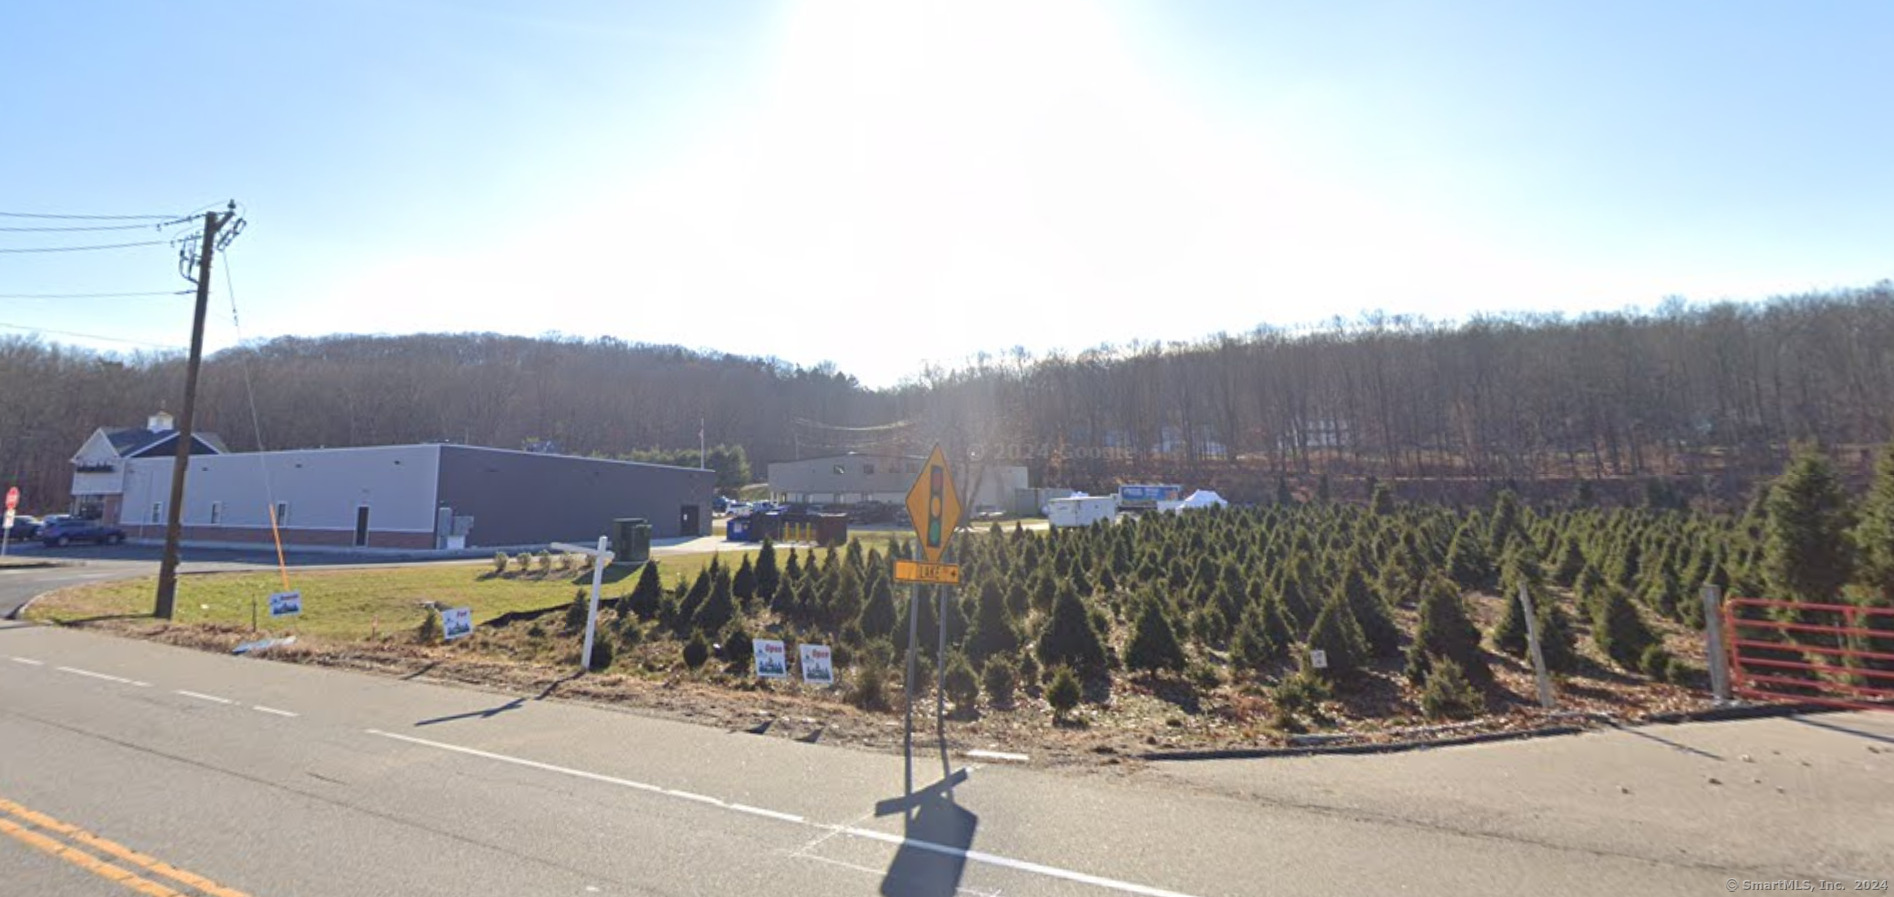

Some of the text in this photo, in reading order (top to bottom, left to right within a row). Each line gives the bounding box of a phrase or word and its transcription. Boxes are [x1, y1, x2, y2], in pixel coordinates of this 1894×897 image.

[920, 565, 940, 580] LAKE
[765, 644, 782, 653] Open
[812, 649, 829, 658] Open
